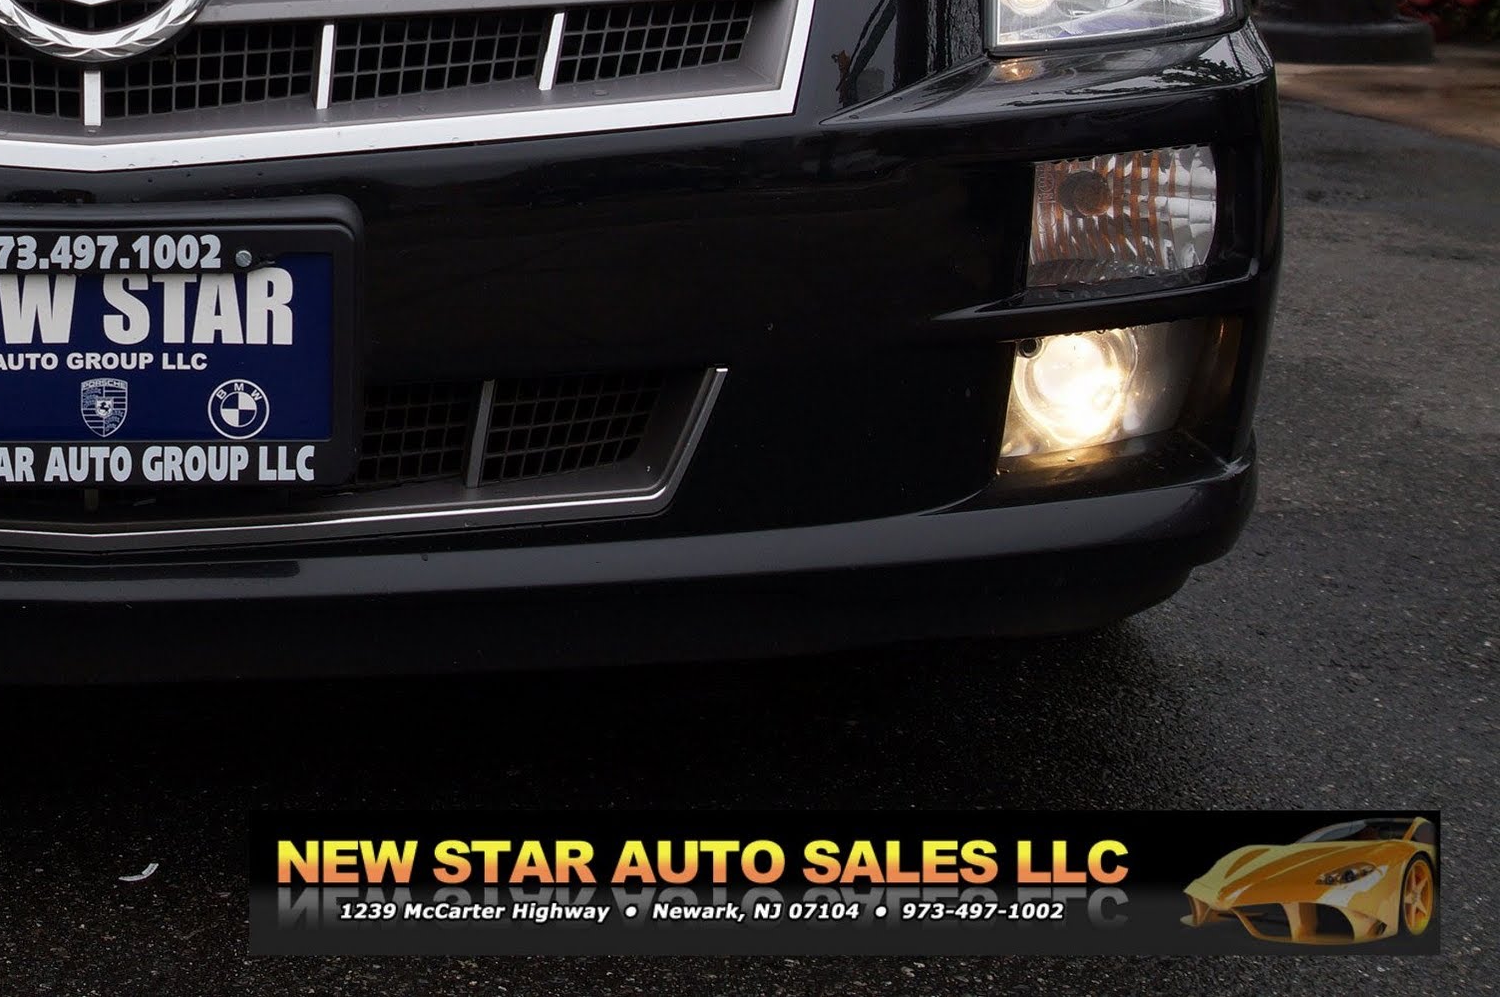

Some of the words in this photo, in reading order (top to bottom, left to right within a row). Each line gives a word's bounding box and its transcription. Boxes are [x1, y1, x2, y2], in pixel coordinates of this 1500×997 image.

[102, 269, 294, 345] STAR
[66, 352, 154, 370] GROUP
[162, 352, 208, 371] LLC
[215, 382, 263, 402] BMW
[43, 445, 133, 482] AUTO
[141, 445, 249, 482] GROUP
[258, 444, 315, 482] LLC
